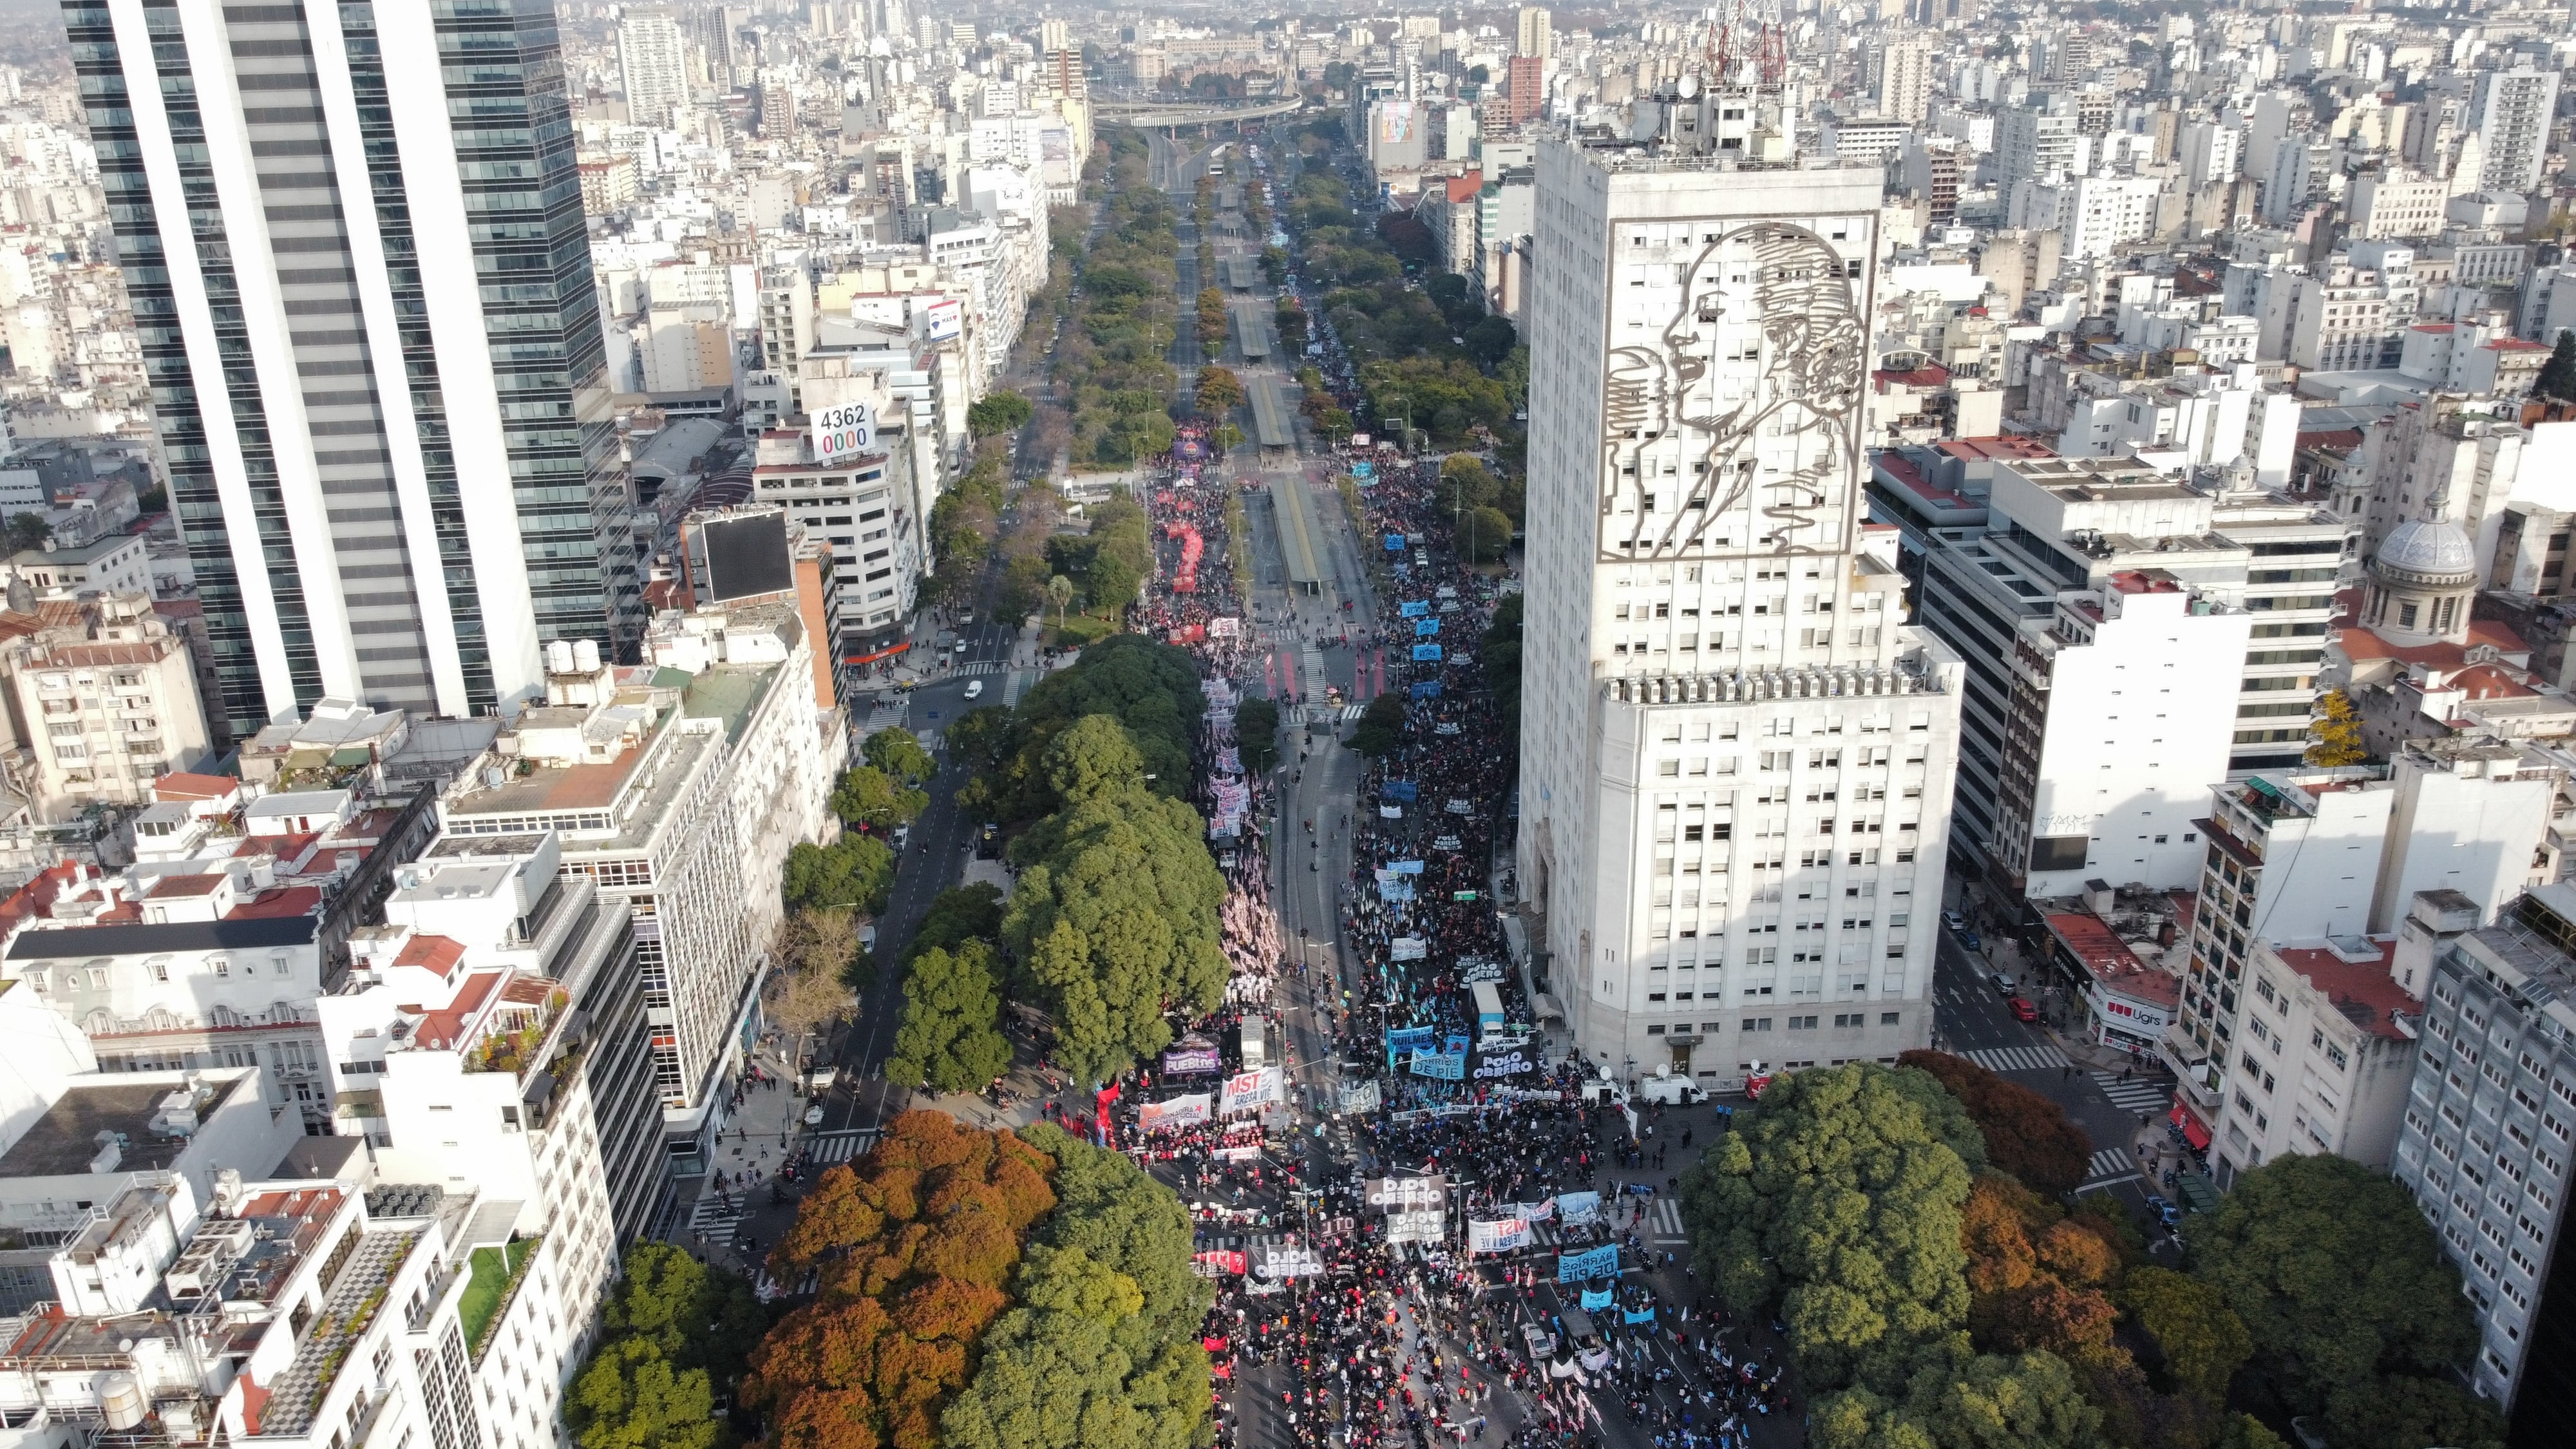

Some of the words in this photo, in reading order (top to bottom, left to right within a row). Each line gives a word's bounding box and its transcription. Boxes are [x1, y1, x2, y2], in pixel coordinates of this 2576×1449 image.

[821, 404, 866, 430] 4362
[823, 428, 867, 453] 0000
[1462, 970, 1502, 983] OBRERO
[1467, 963, 1497, 976] POLO
[1391, 1033, 1432, 1045] QUILMES
[1166, 1058, 1216, 1071] PUEBLOS
[1483, 1051, 1522, 1067] POLO
[1414, 1062, 1432, 1074] DE
[1437, 1068, 1459, 1077] PIE
[1473, 1061, 1532, 1079] OBRERO
[1226, 1072, 1261, 1097] MST
[1260, 1084, 1272, 1101] VIE
[1179, 1112, 1200, 1121] SCIAL
